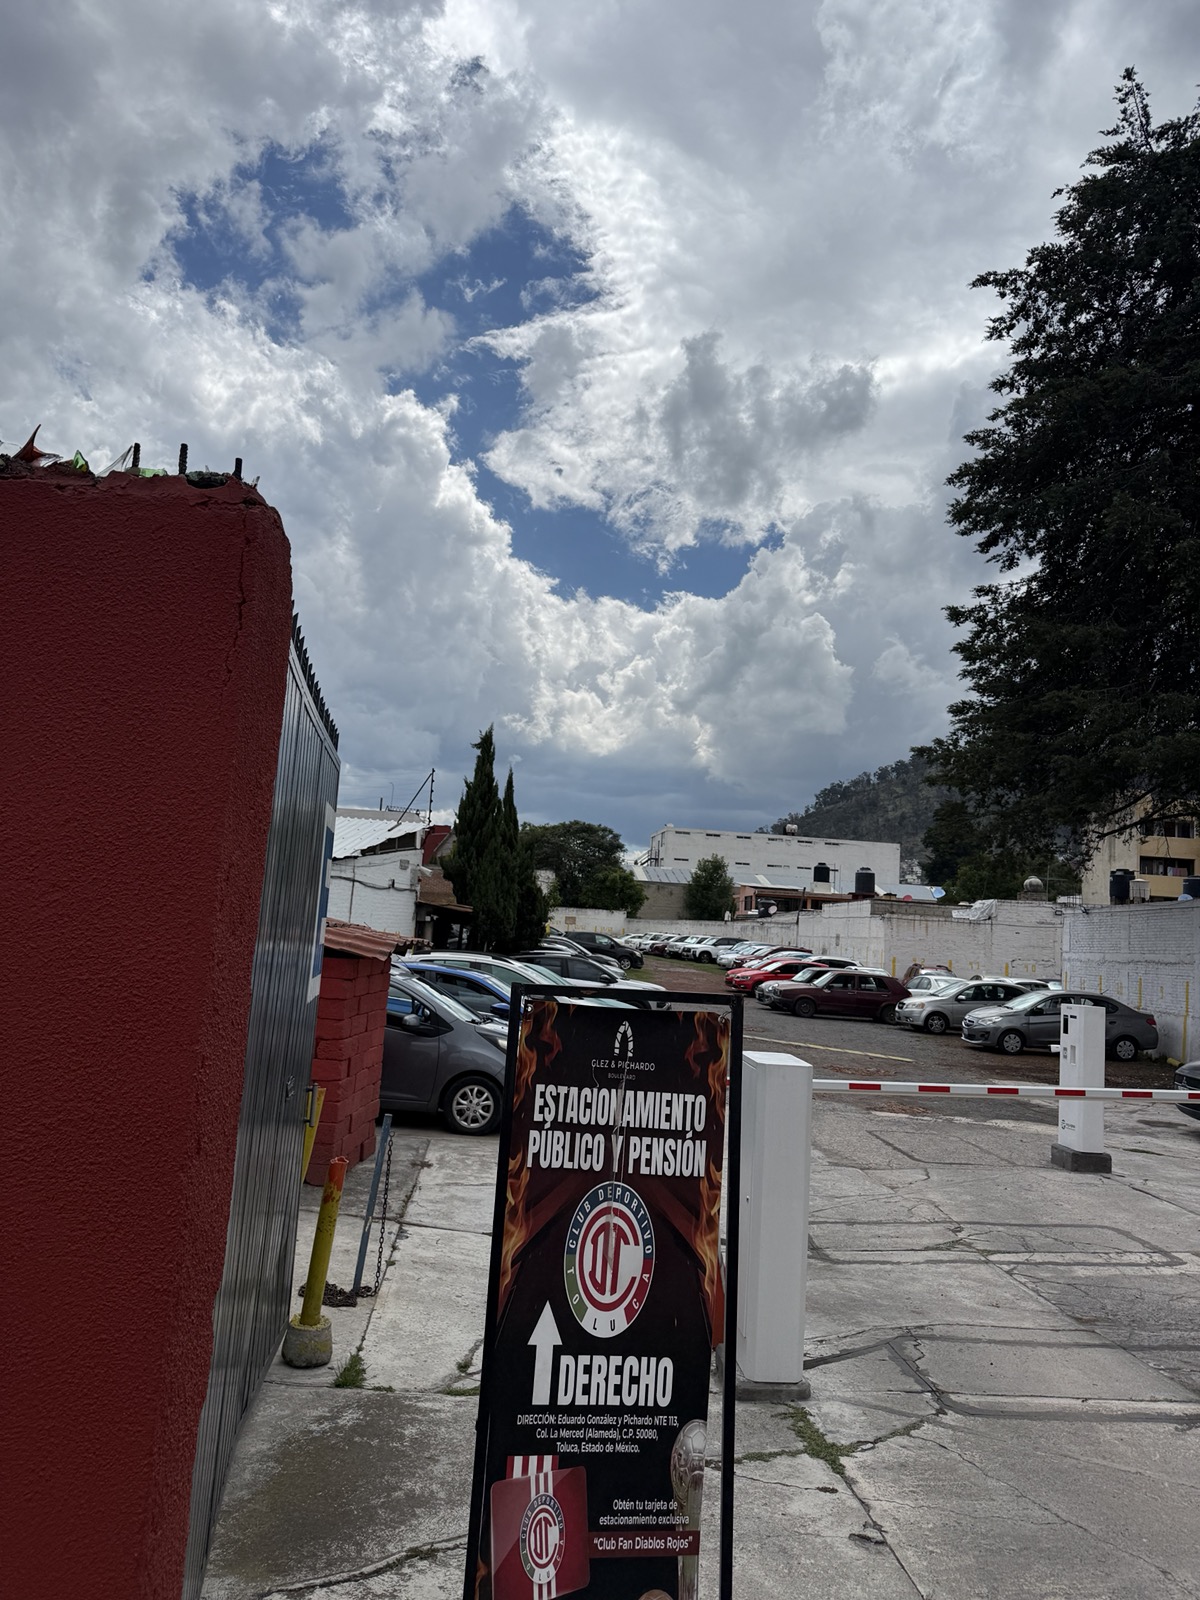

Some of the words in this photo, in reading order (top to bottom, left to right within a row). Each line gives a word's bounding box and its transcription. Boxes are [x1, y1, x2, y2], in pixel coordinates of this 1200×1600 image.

[591, 1059, 609, 1068] GLEZ
[611, 1060, 616, 1068] &
[618, 1060, 656, 1071] PICHARDO
[608, 1072, 636, 1080] BOULEVARD
[533, 1083, 707, 1132] ESTACIONAMIENTO
[526, 1121, 605, 1172] PÚBLICO
[611, 1133, 624, 1173] Y
[628, 1130, 707, 1177] PENSIÓN
[568, 1201, 591, 1249] CLUB
[598, 1186, 653, 1254] DEPORTIVO
[557, 1355, 674, 1408] DERECHO
[517, 1412, 557, 1425] DIRECCIÓN:
[557, 1413, 586, 1425] Eduardo
[586, 1413, 617, 1426] González
[617, 1416, 623, 1427] y
[623, 1414, 652, 1426] Pichardo
[653, 1415, 667, 1426] NTE
[668, 1415, 679, 1428] 113,
[536, 1428, 549, 1439] Col.
[550, 1428, 559, 1439] La
[559, 1428, 585, 1439] Merced
[585, 1428, 621, 1441] (Alameda),
[622, 1428, 635, 1439] C.P.
[636, 1428, 659, 1441] 50080,
[556, 1441, 580, 1454] Toluca,
[581, 1441, 604, 1453] Estado
[605, 1441, 614, 1453] de
[615, 1441, 640, 1453] México.
[612, 1498, 635, 1510] Obtén
[635, 1500, 644, 1510] tu
[644, 1499, 667, 1512] tarjeta
[668, 1498, 678, 1510] de
[599, 1513, 657, 1525] estacionamiento
[658, 1513, 690, 1525] exclusiva
[618, 1537, 633, 1550] Fan
[635, 1536, 665, 1549] Diablos
